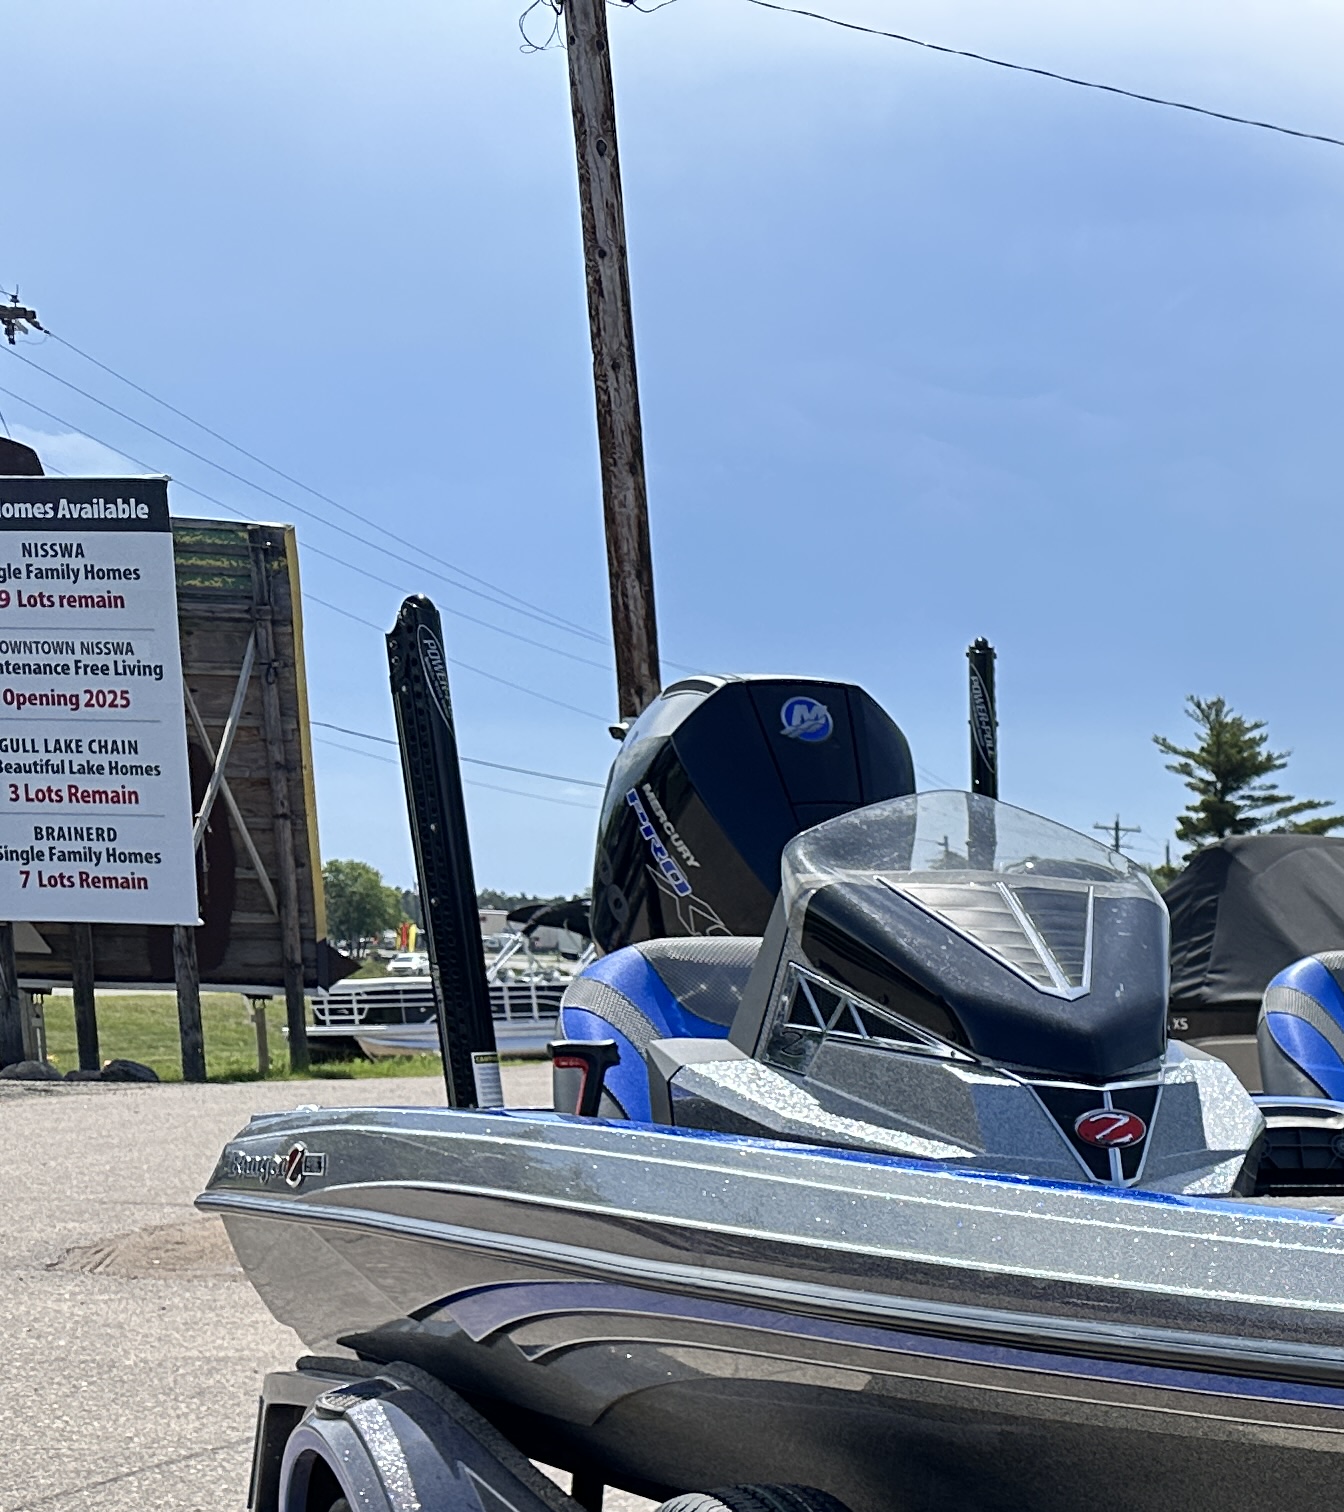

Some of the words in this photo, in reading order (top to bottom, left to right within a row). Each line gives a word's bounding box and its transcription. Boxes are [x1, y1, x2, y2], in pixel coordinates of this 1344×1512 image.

[0, 502, 54, 519] omes
[57, 498, 149, 519] Available
[21, 542, 85, 559] NISSWA
[0, 563, 22, 584] gle
[25, 563, 80, 584] Family
[84, 564, 141, 581] Homes
[16, 590, 55, 608] Lots
[58, 590, 125, 609] remain
[0, 640, 75, 656] OWNTOWN
[80, 641, 135, 656] NISSWA
[74, 659, 109, 676] Free
[113, 659, 164, 681] Living
[3, 688, 80, 711] Opening
[83, 689, 131, 709] 2025
[0, 738, 39, 754] GULL
[44, 738, 83, 754] LAKE
[88, 739, 139, 755] CHAIN
[69, 759, 105, 775] Lake
[108, 760, 161, 776] Homes
[8, 783, 20, 802] 3
[24, 783, 64, 803] Lots
[67, 784, 140, 805] Remain
[34, 826, 118, 842] BRAINERD
[642, 783, 700, 868] MERCURY
[626, 788, 692, 897] PRO
[48, 846, 102, 867] Family
[106, 847, 162, 864] Homes
[19, 870, 31, 889] 7
[37, 870, 75, 889] Lots
[78, 871, 149, 890] Remain
[1172, 1017, 1189, 1031] XS
[1089, 1112, 1134, 1145] Z
